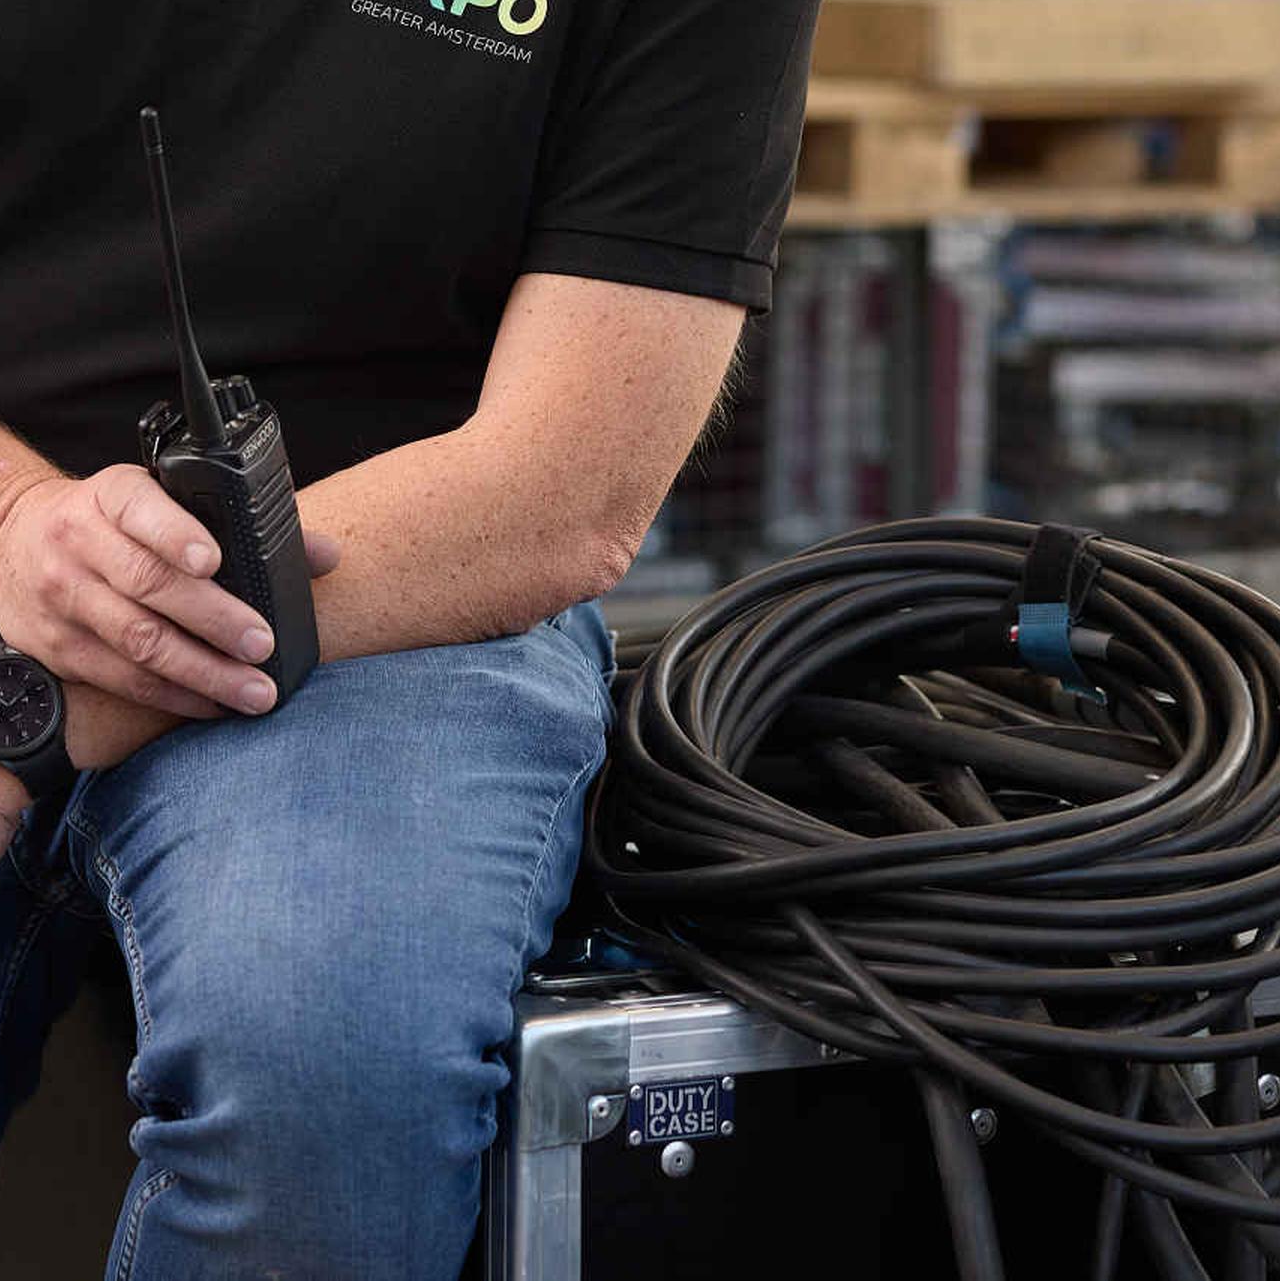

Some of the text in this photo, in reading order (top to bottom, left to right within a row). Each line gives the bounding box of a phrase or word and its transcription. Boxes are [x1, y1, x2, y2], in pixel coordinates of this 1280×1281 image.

[425, 20, 532, 63] AMSTERDAM
[241, 421, 275, 460] KENWOOD
[649, 1085, 715, 1116] DUTY
[649, 1110, 715, 1137] CASE
